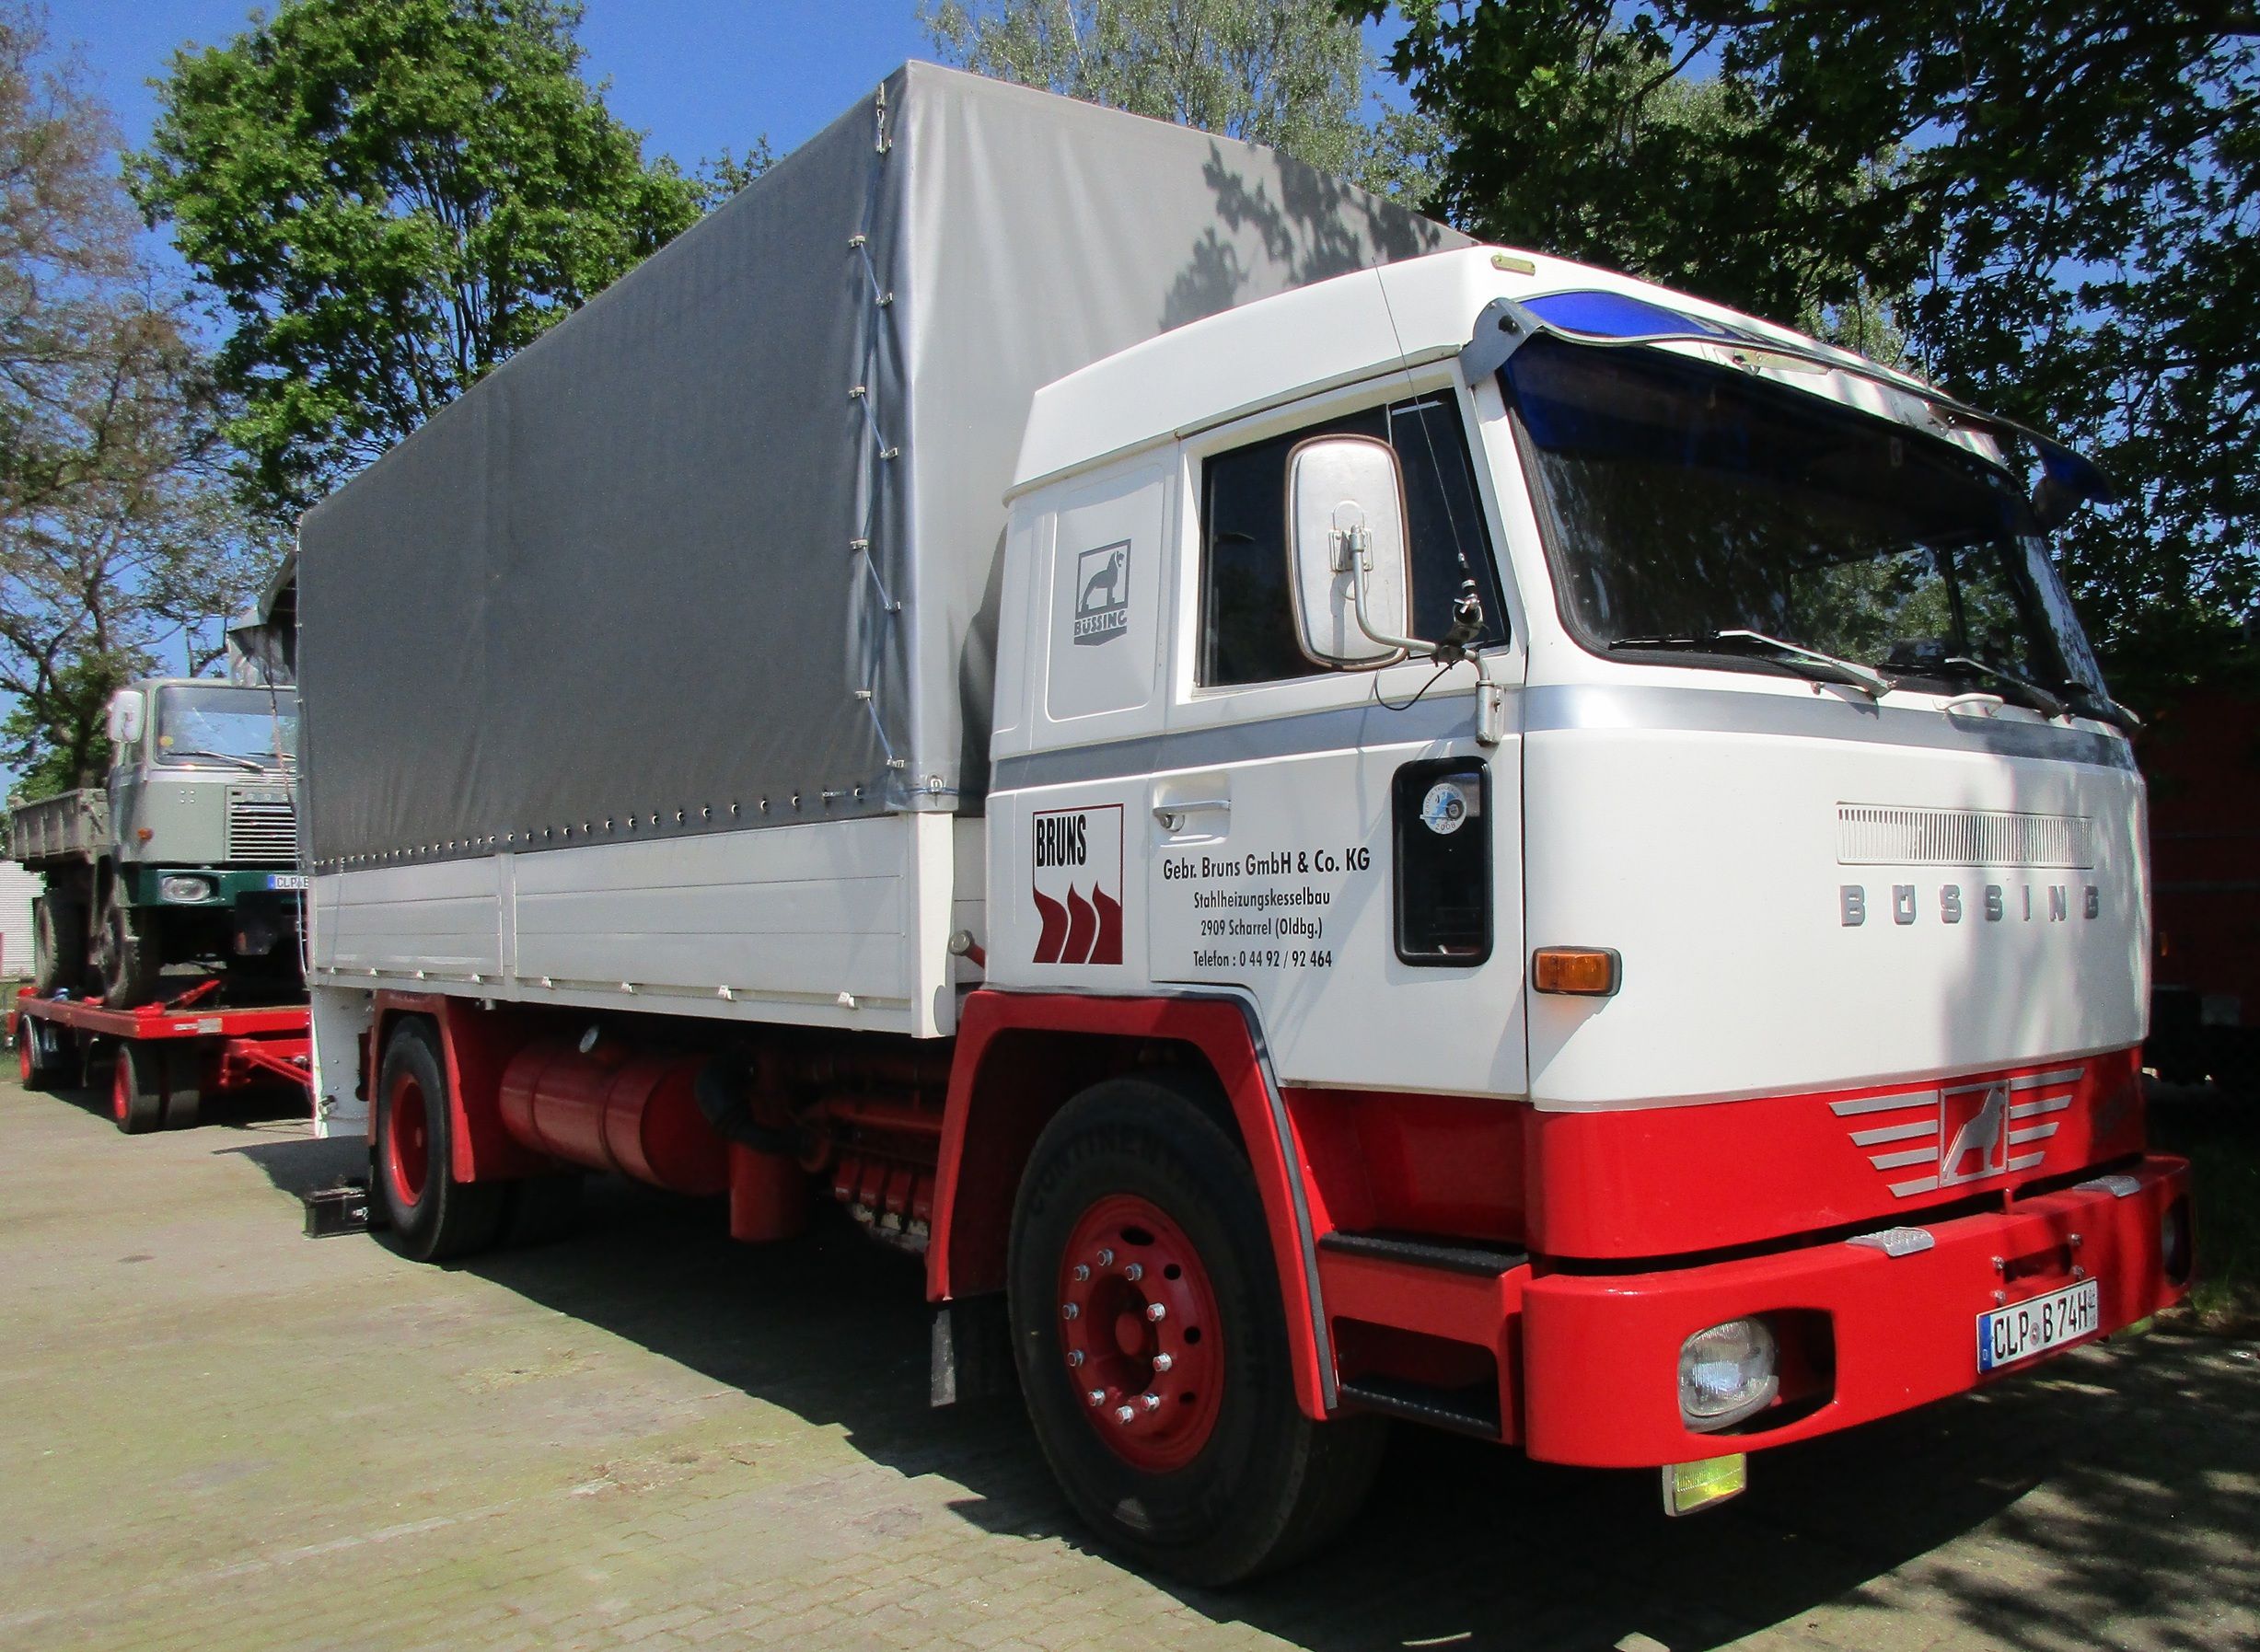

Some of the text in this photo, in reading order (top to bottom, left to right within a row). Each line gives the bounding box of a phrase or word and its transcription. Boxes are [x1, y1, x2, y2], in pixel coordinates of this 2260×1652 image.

[1074, 609, 1128, 636] BÜSSING
[1435, 823, 1455, 831] 2008
[1036, 814, 1087, 867] BRUNS
[1164, 847, 1370, 880] Gebr. Bruns GmbH & Co. KG
[277, 876, 297, 888] CLP
[1194, 886, 1330, 911] Stahlheizungskesselbau
[1200, 917, 1323, 940] 2909 Scharrel (Oldbg.)
[1193, 950, 1230, 967] Telefon
[1239, 951, 1246, 967] 0
[1249, 951, 1263, 967] 44
[1266, 951, 1280, 967] 92
[1292, 951, 1306, 967] 92
[1310, 950, 1333, 967] 464
[1994, 1311, 2029, 1359] CLP
